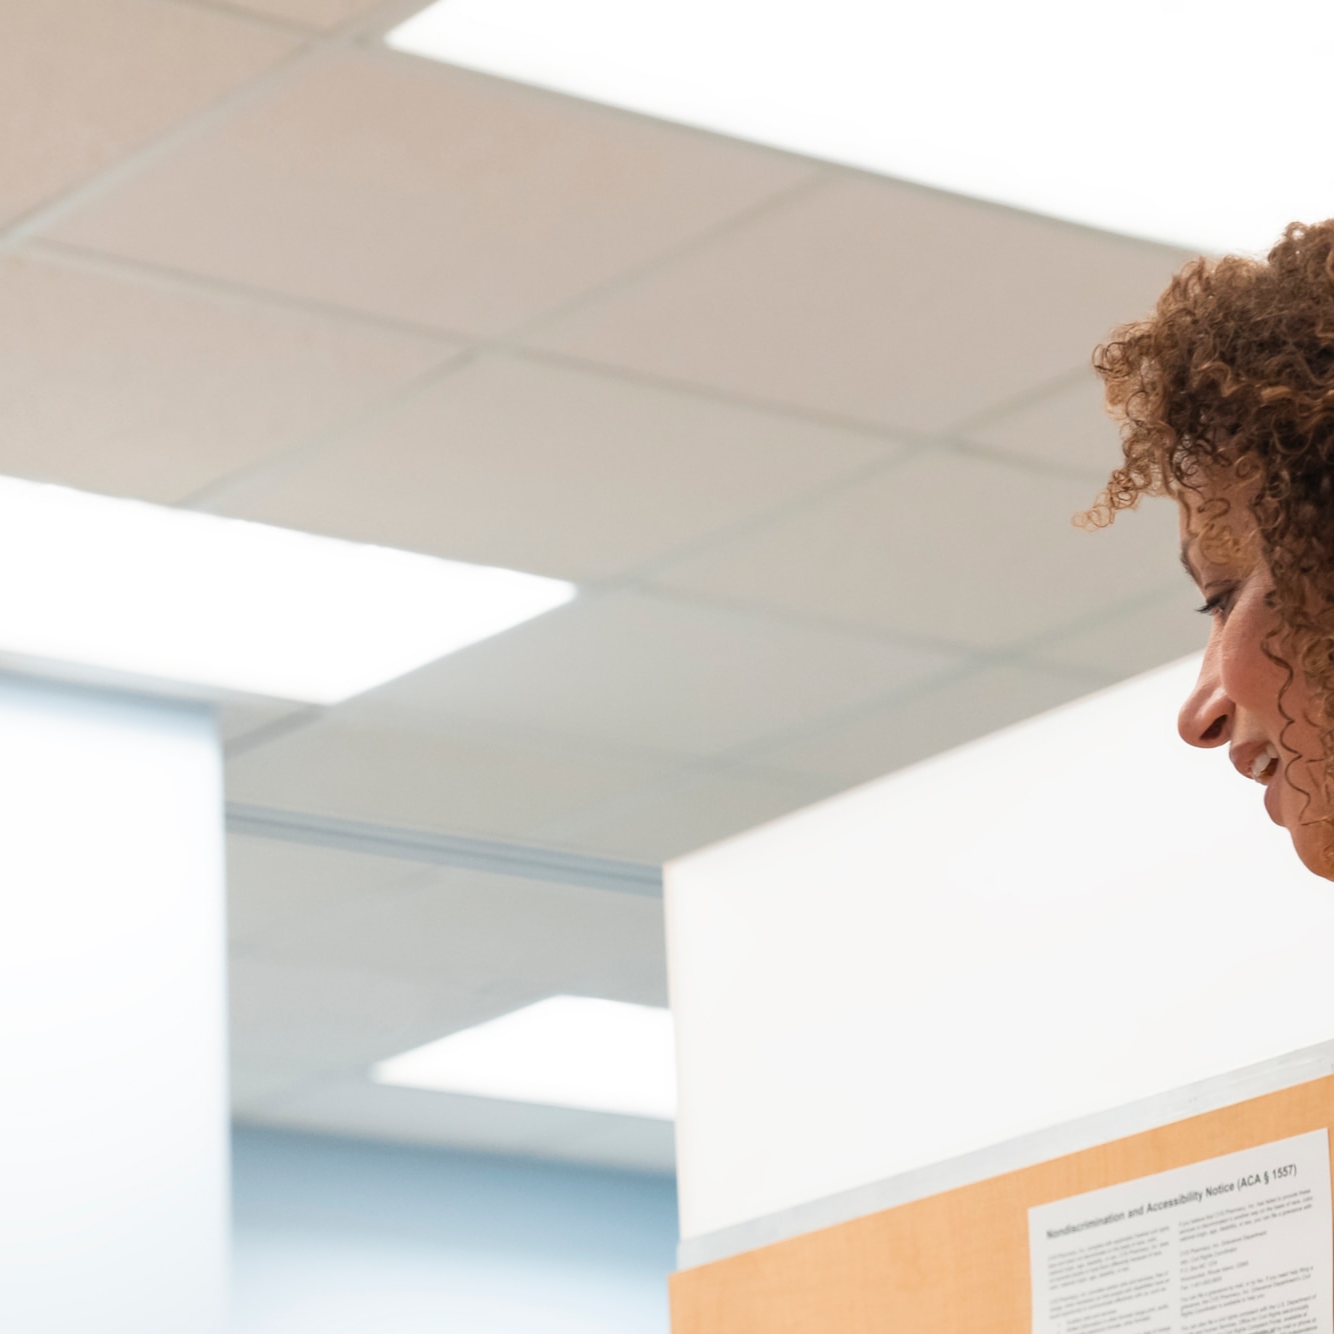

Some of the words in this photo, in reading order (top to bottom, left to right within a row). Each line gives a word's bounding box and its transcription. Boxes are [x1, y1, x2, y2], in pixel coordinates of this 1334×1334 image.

[1046, 1212, 1125, 1239] Nondiscrimination
[1128, 1204, 1144, 1218] and
[1147, 1190, 1203, 1213] Accessibility
[1205, 1181, 1235, 1198] Notice
[1237, 1173, 1261, 1191] (ACA
[1272, 1163, 1297, 1180] 1557)
